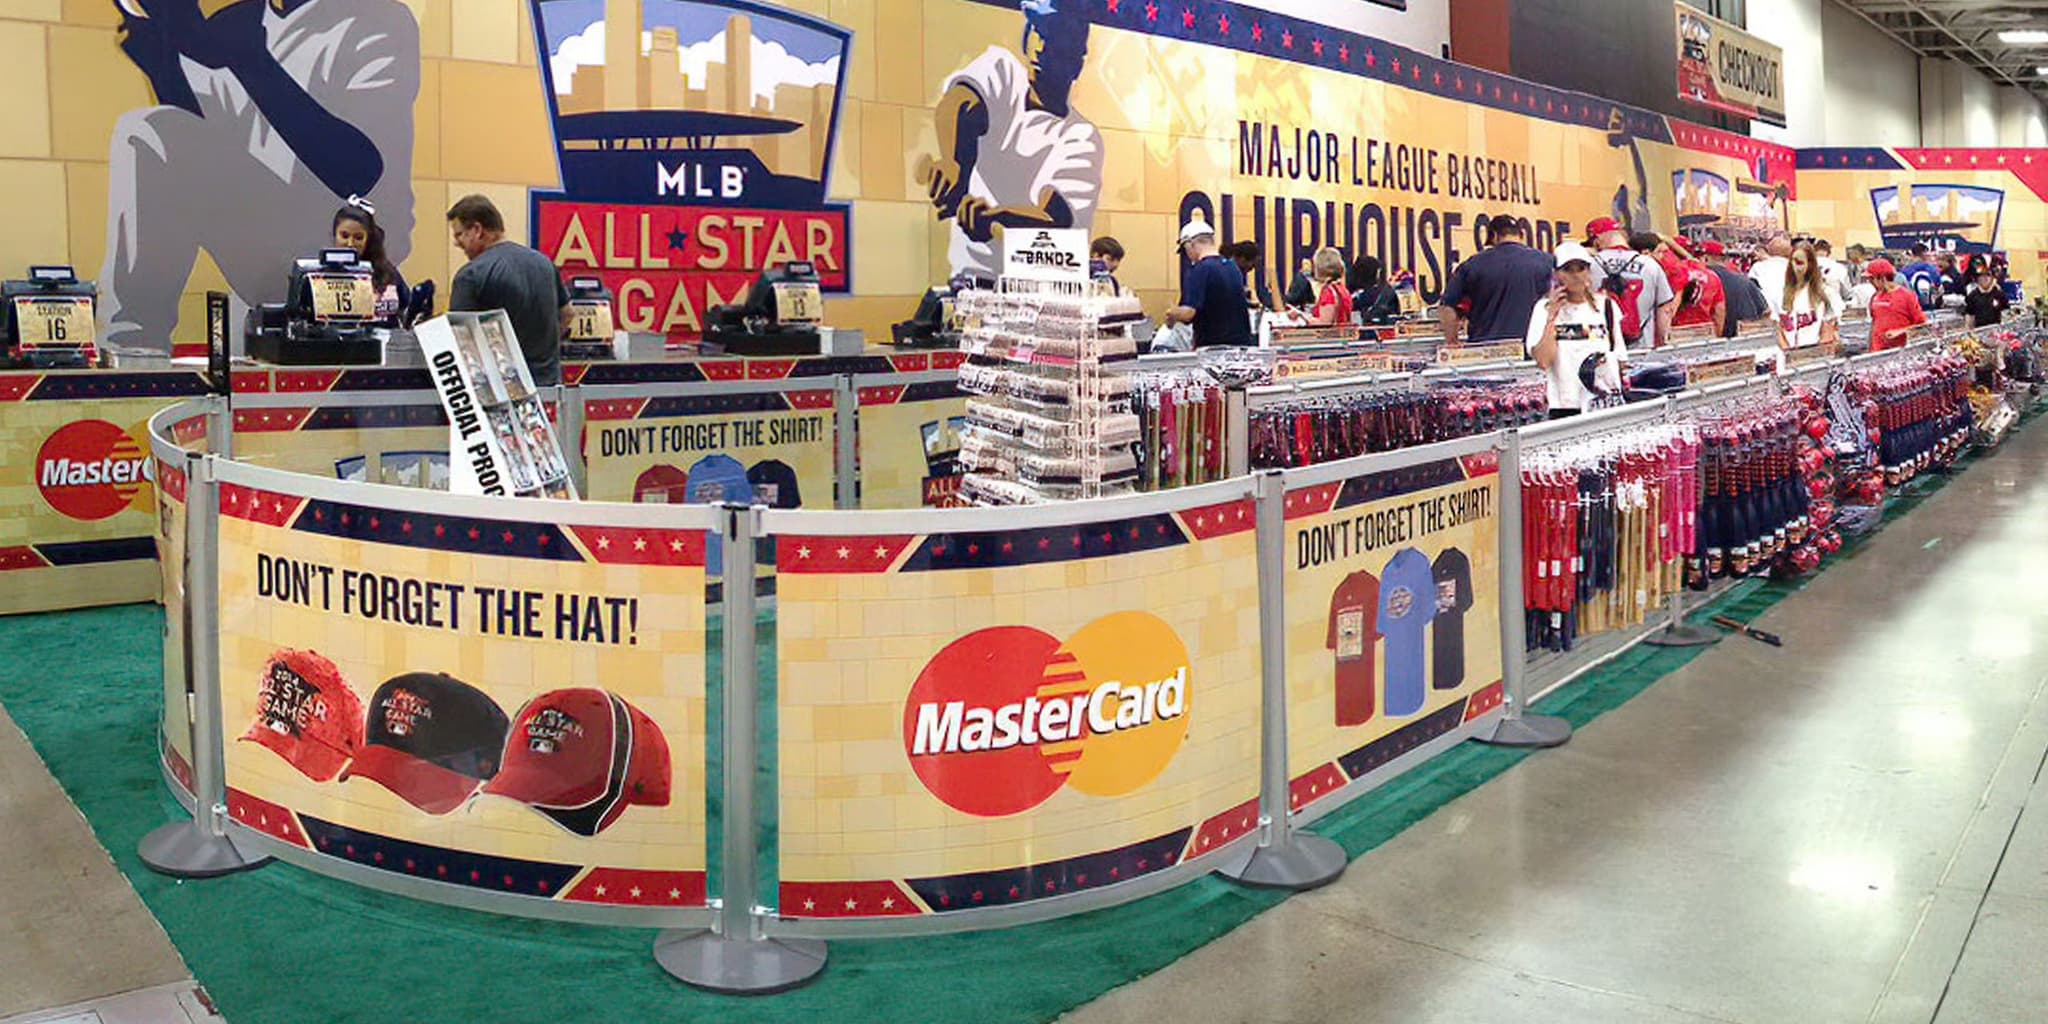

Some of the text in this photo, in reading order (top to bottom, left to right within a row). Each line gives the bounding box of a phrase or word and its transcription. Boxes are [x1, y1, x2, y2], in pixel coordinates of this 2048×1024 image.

[1719, 40, 1778, 99] CHECKOUT
[1238, 119, 1542, 206] MAJOR LEAGUE BASEBALL
[553, 211, 838, 271] ALL STAR
[47, 317, 66, 340] 16
[335, 291, 352, 312] 15
[580, 318, 593, 336] 14
[432, 350, 483, 441] OFFICIAL
[600, 415, 824, 458] DON'T FORGET THE SHIRT!
[1297, 485, 1491, 570] DON'T FORGET THE SHIRT!
[257, 553, 639, 646] DON'T FORGET THE HAT!
[281, 682, 328, 722] STAR
[912, 666, 1188, 756] MasterCard
